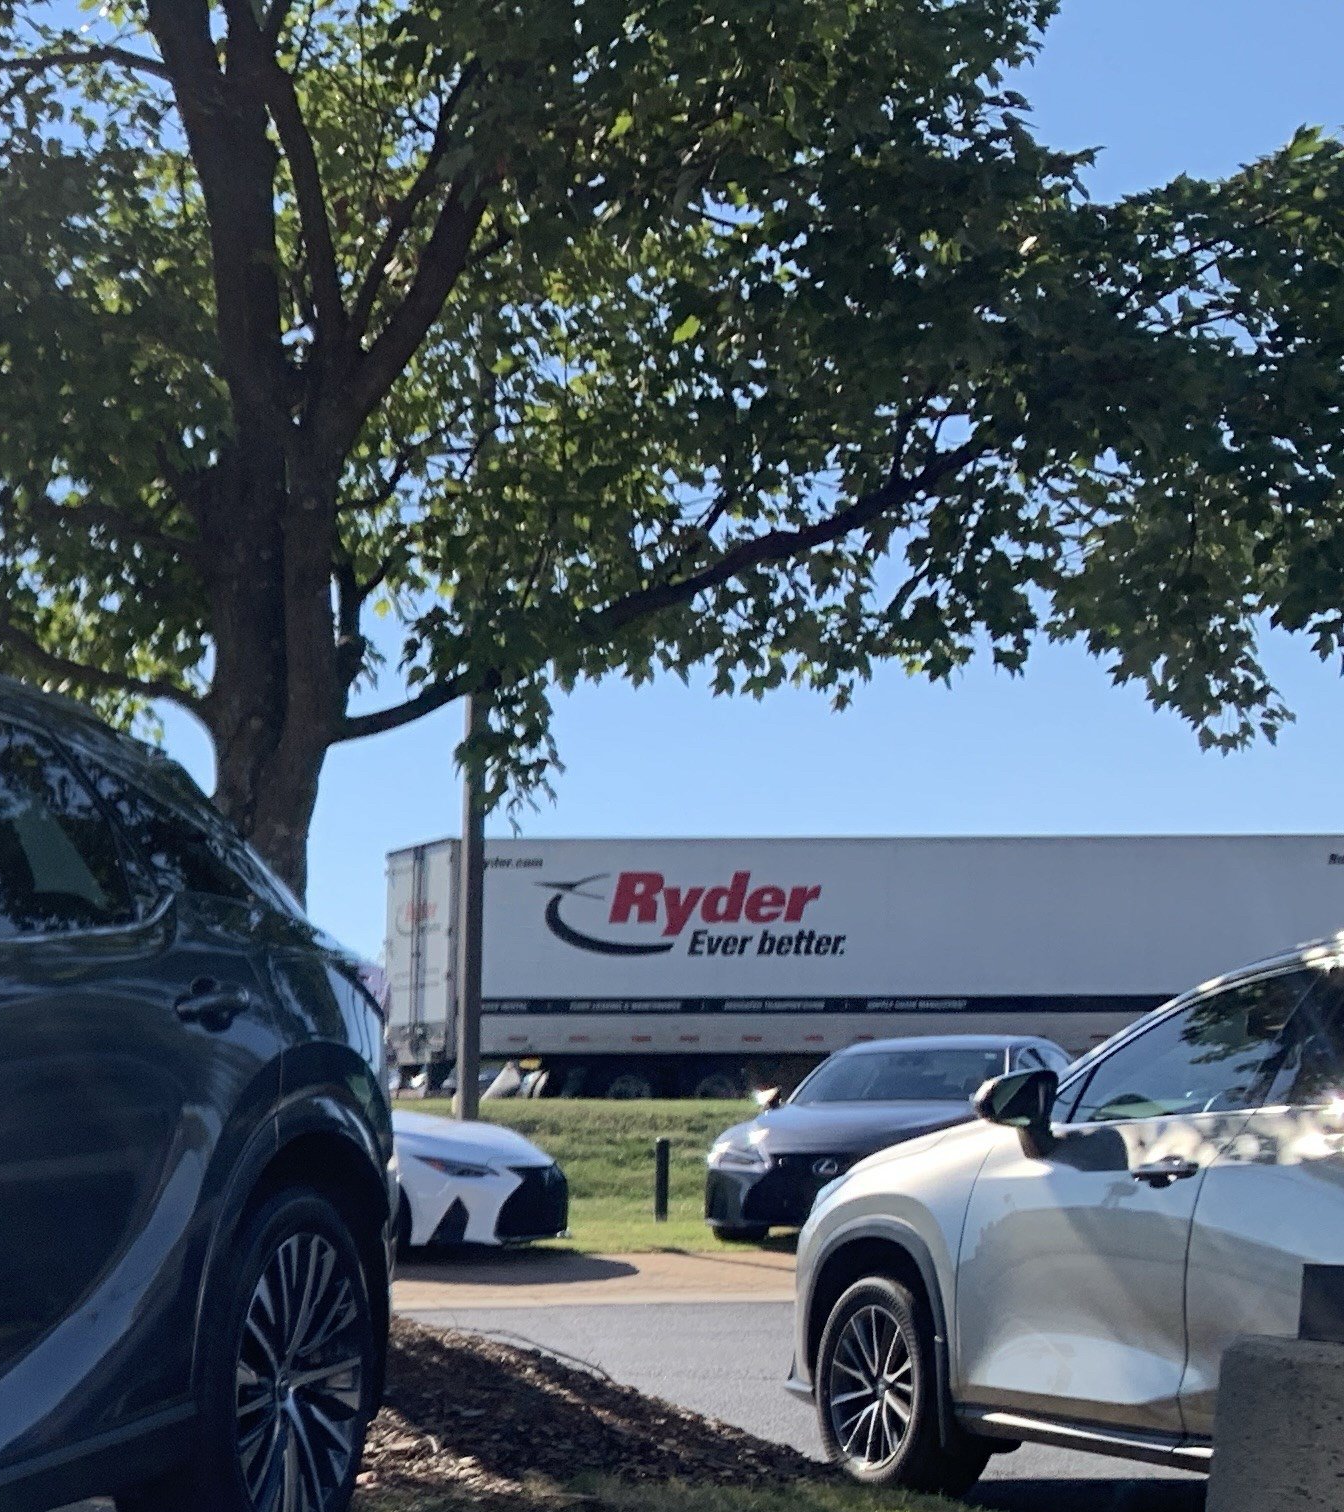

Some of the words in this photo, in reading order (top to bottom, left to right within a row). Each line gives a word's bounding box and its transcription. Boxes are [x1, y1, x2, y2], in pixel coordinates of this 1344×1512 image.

[609, 870, 822, 936] Ryder
[687, 929, 754, 957] Ever
[757, 929, 847, 957] better.
